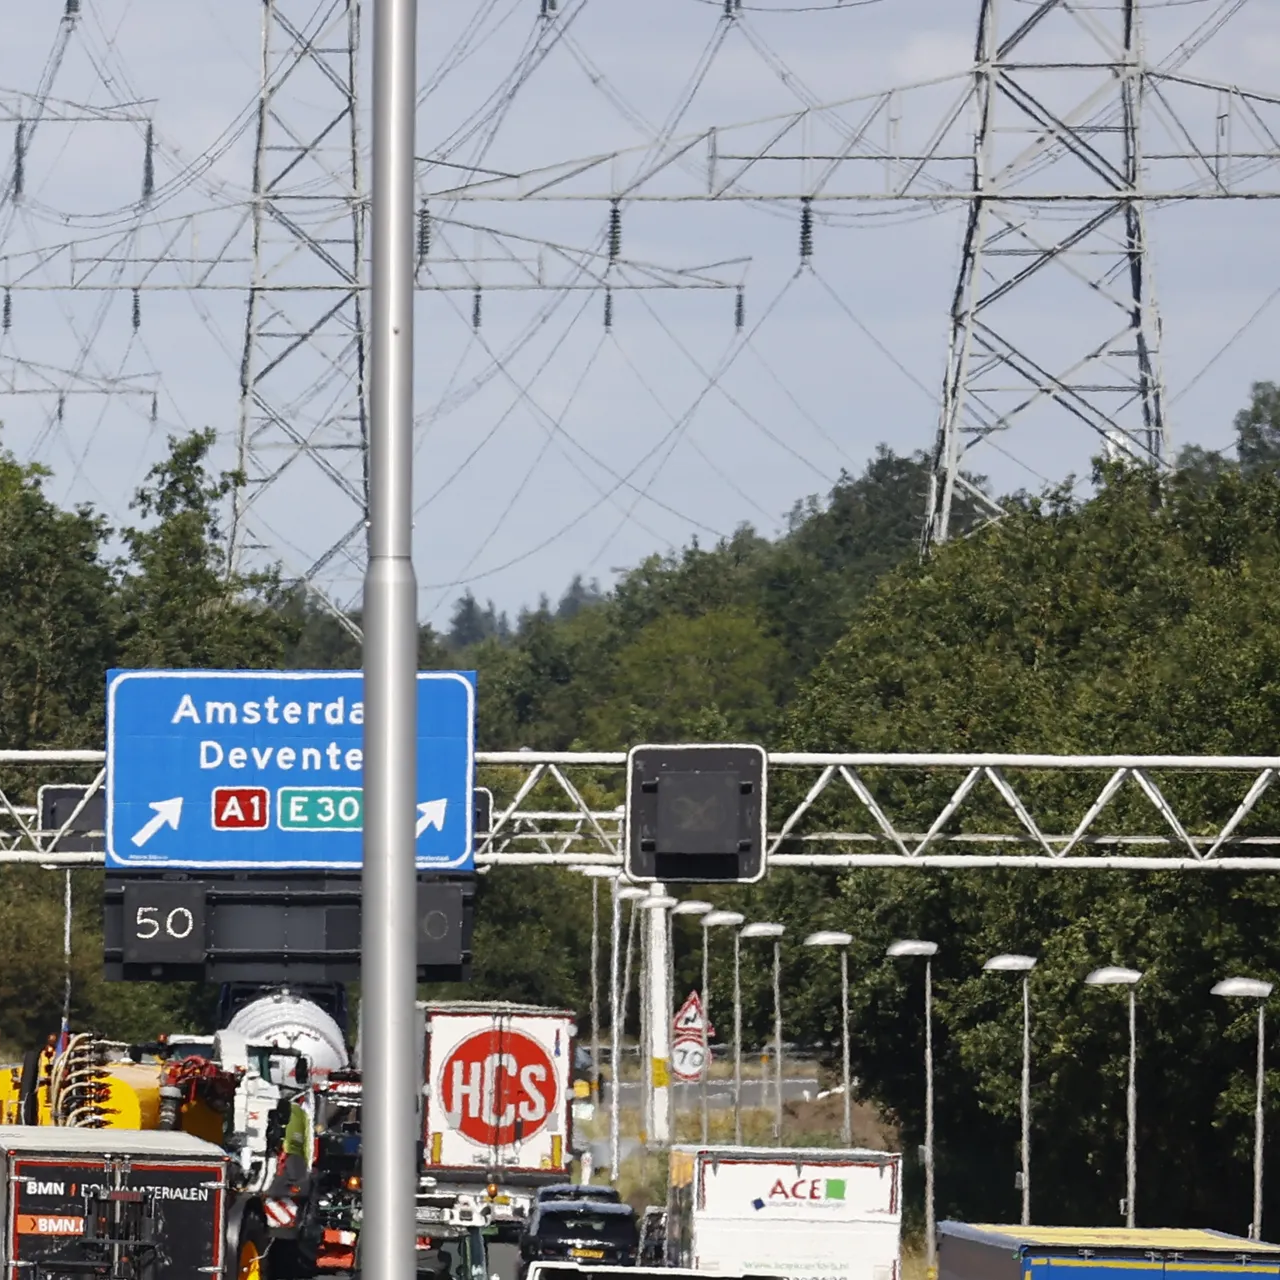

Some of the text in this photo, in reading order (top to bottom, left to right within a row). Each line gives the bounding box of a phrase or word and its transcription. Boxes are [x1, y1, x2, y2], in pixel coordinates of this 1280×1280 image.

[170, 693, 364, 726] Amsterda
[199, 740, 364, 772] Devente
[220, 795, 260, 822] A1
[136, 906, 194, 939] 50
[676, 1048, 704, 1067] 70
[451, 1052, 548, 1128] HCS
[26, 1182, 65, 1196] BMN
[768, 1178, 822, 1200] ACE
